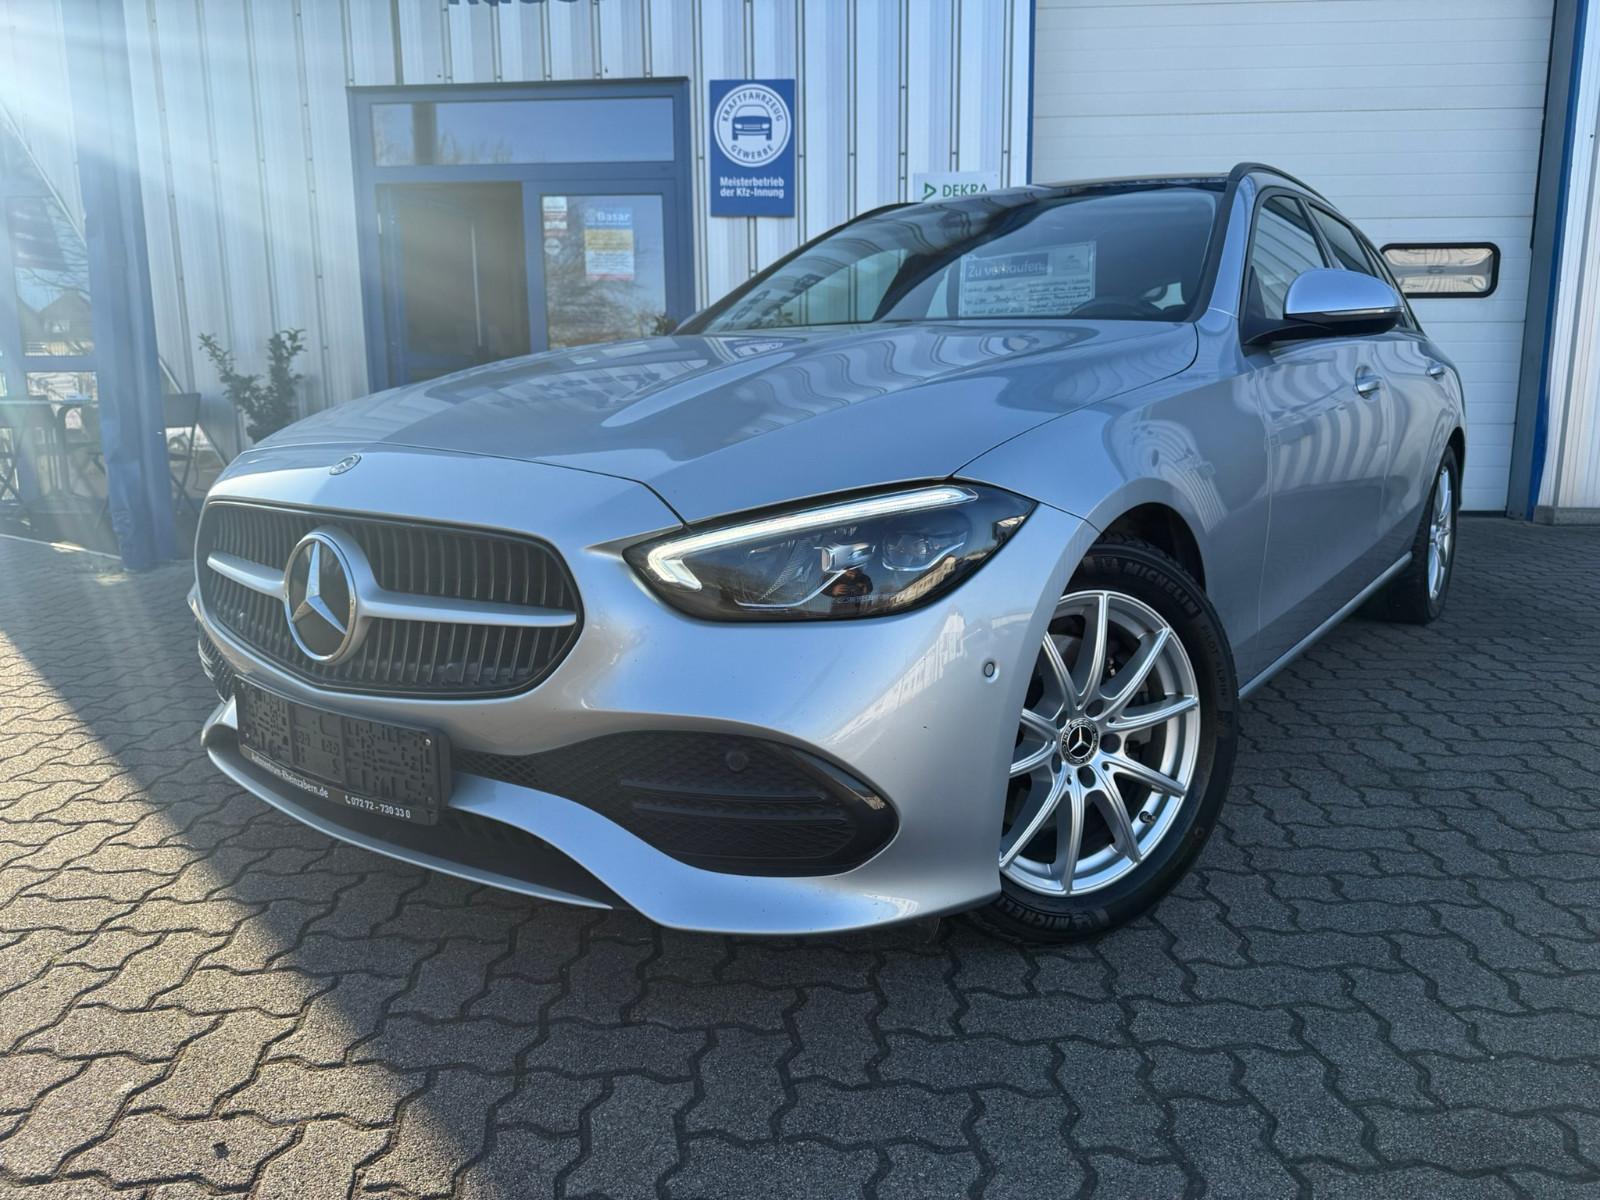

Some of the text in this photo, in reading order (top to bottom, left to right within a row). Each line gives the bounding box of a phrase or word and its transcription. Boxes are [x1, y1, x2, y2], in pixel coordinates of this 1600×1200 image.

[722, 92, 783, 122] KRAFTFAHRZEUG
[731, 144, 773, 160] GEWERBE
[720, 177, 784, 187] Meisterbetrieb
[720, 188, 784, 199] der Kfz-Innung
[1123, 561, 1202, 617] MICHELIN
